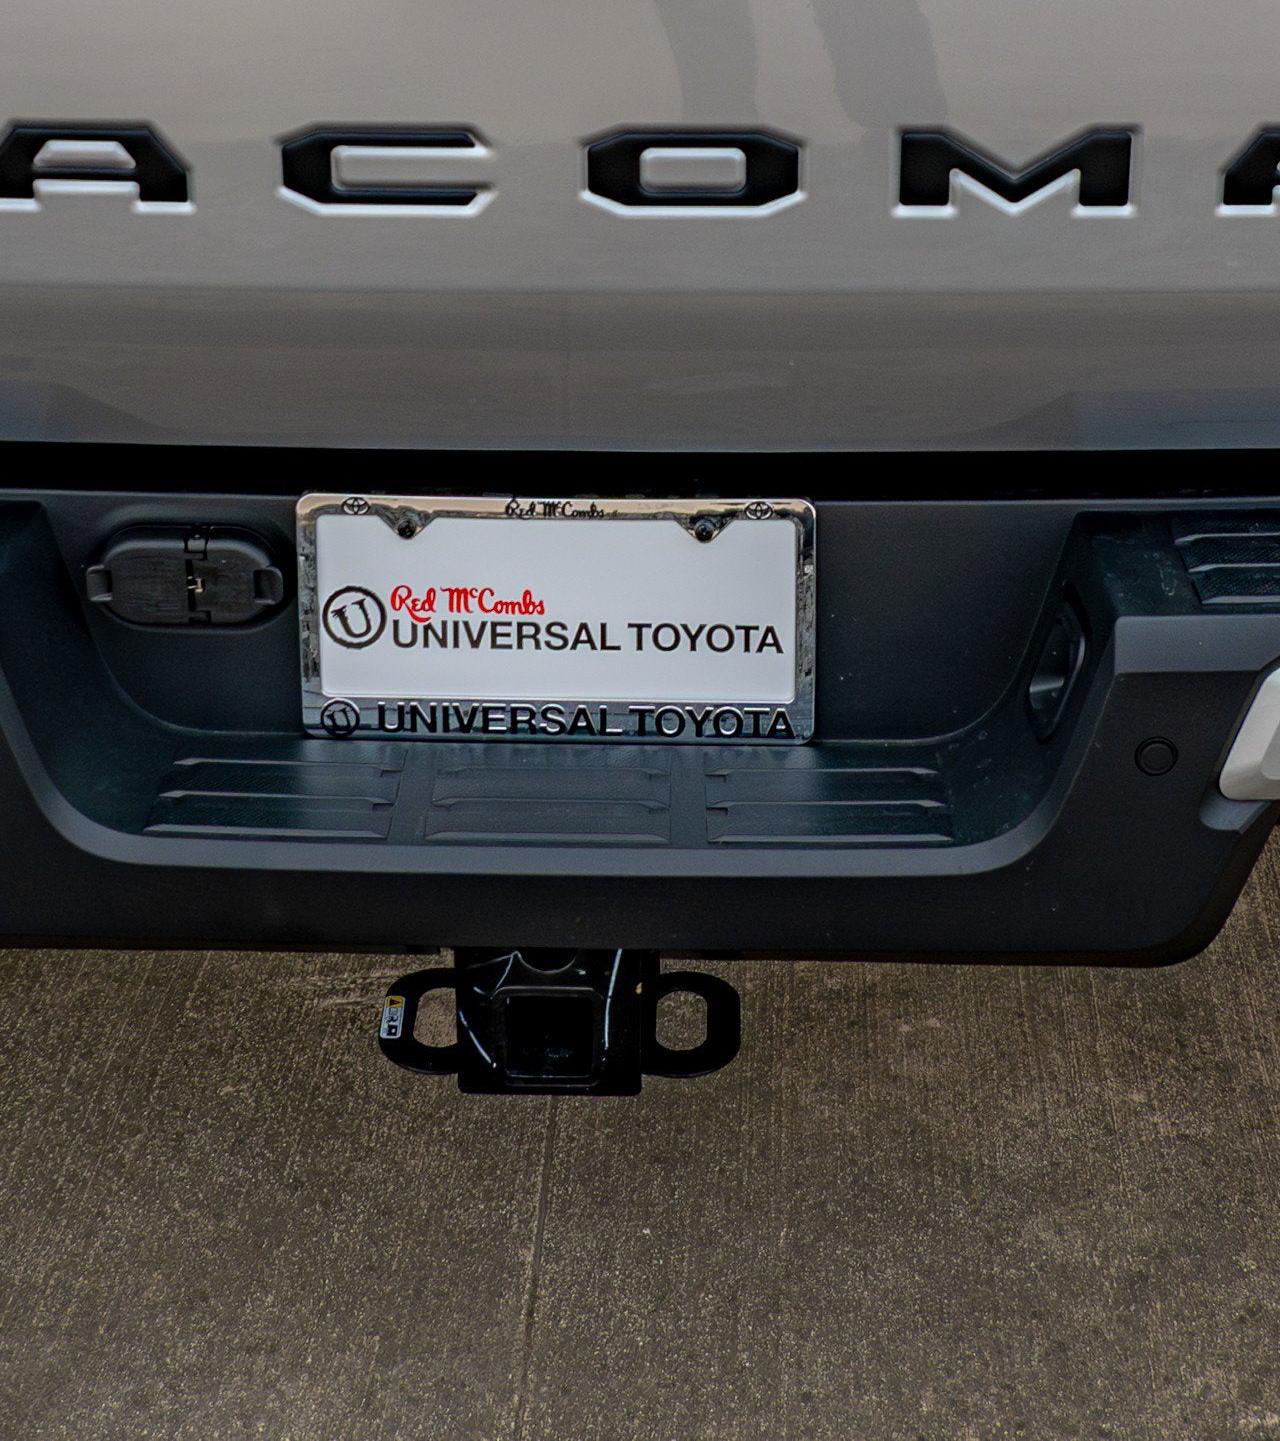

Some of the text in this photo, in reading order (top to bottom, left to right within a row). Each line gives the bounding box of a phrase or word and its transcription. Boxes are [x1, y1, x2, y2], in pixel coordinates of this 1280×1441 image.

[505, 496, 536, 520] Red
[390, 585, 546, 623] Red McCombs
[393, 621, 784, 654] UNIVERSAL TOYOTA
[376, 702, 623, 736] UNIVERSAL
[628, 705, 796, 738] TOYOTA
